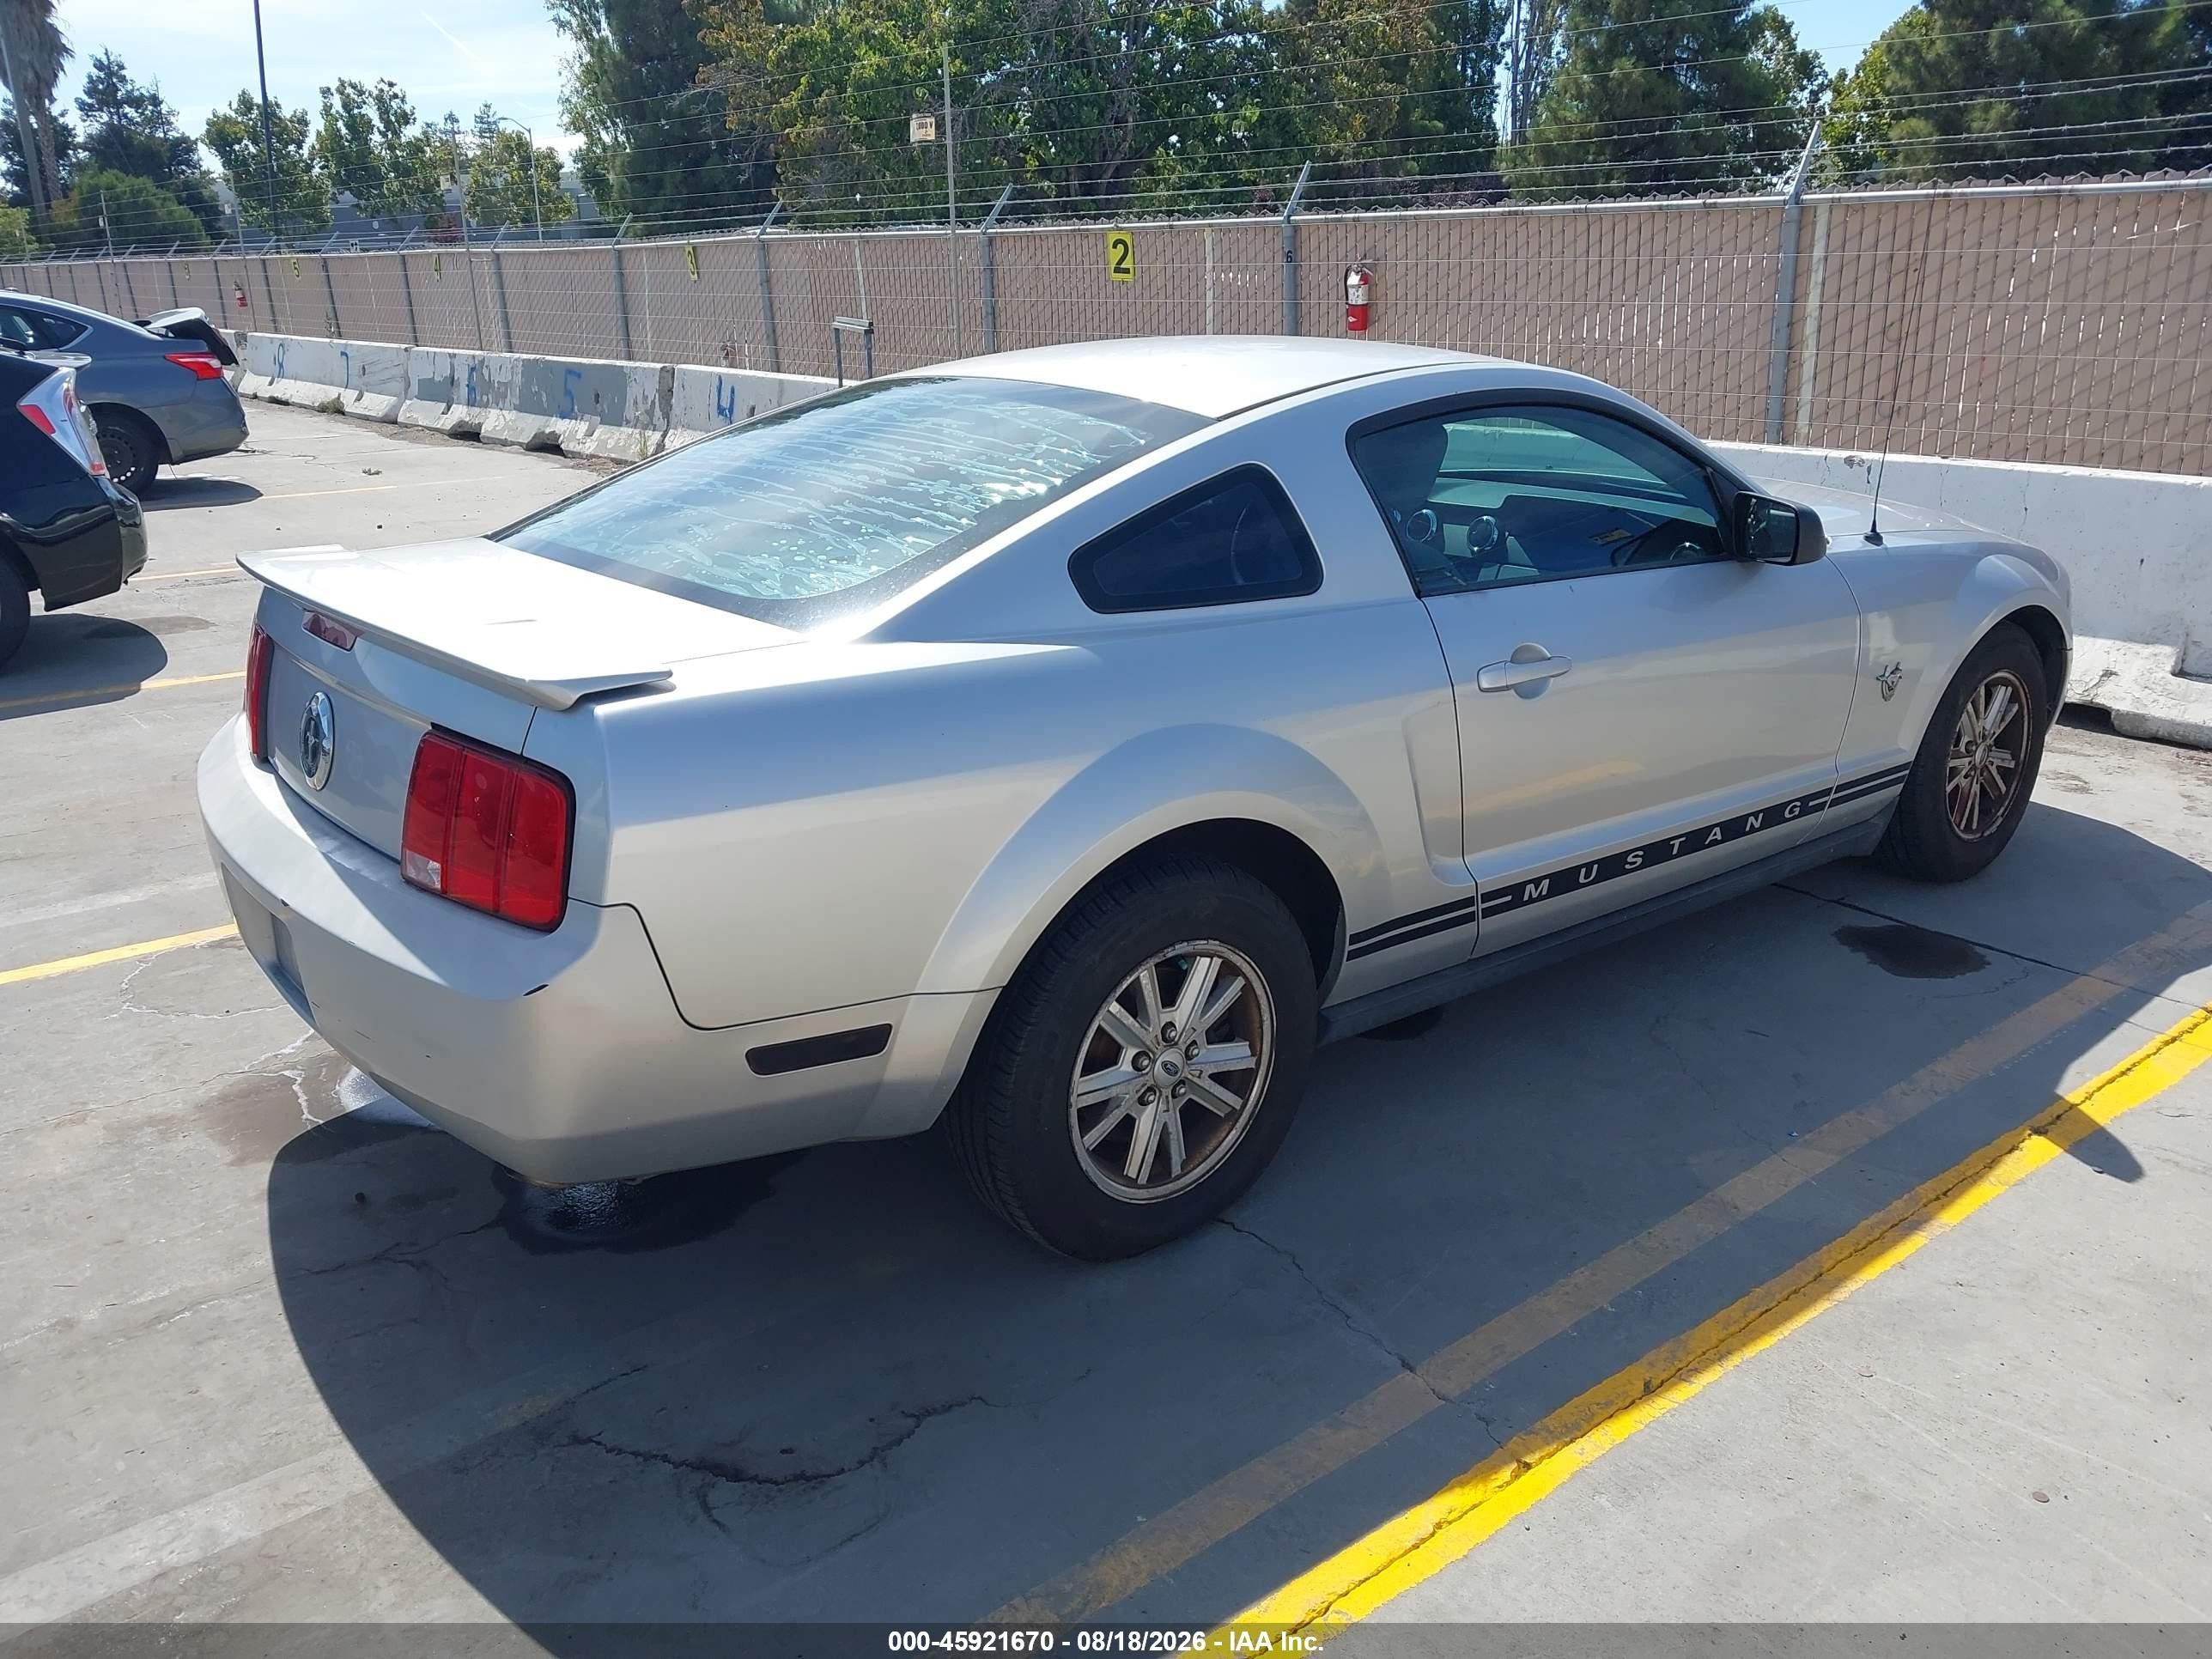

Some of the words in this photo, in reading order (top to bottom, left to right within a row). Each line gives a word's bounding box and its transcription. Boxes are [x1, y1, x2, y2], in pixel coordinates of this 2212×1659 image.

[293, 261, 300, 277] 5
[687, 250, 696, 276] 3
[1112, 238, 1131, 274] 2
[340, 350, 349, 390] 7
[559, 368, 581, 419] 5
[716, 374, 735, 425] 4
[1522, 802, 1802, 902] MUSTANG
